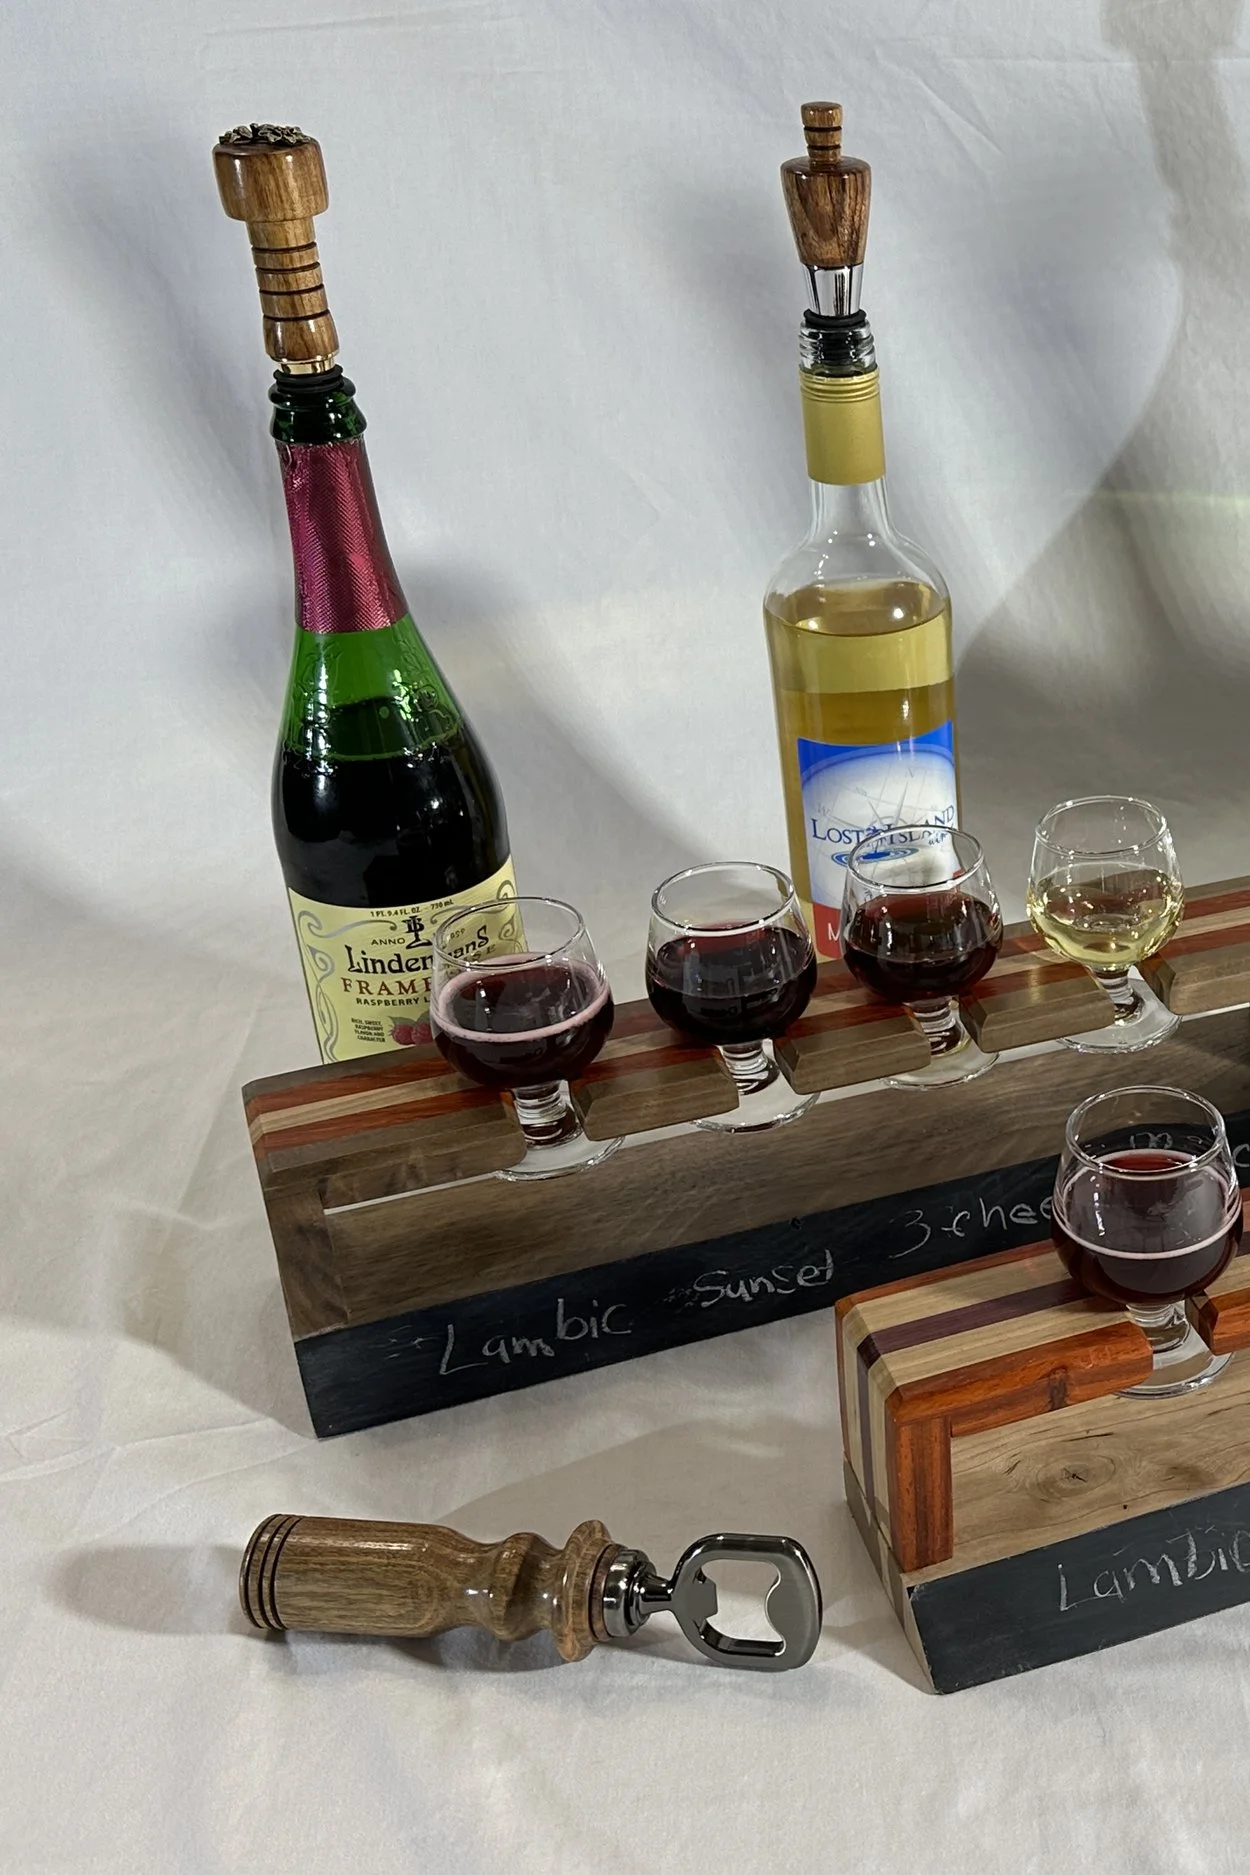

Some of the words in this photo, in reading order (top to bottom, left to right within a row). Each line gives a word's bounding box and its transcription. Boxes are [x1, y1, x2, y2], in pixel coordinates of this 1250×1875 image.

[811, 817, 866, 845] LOST
[371, 937, 406, 946] ANNO
[356, 997, 420, 1007] RASPBERRY
[438, 1298, 633, 1375] Lambic
[692, 1249, 835, 1308] Sunset
